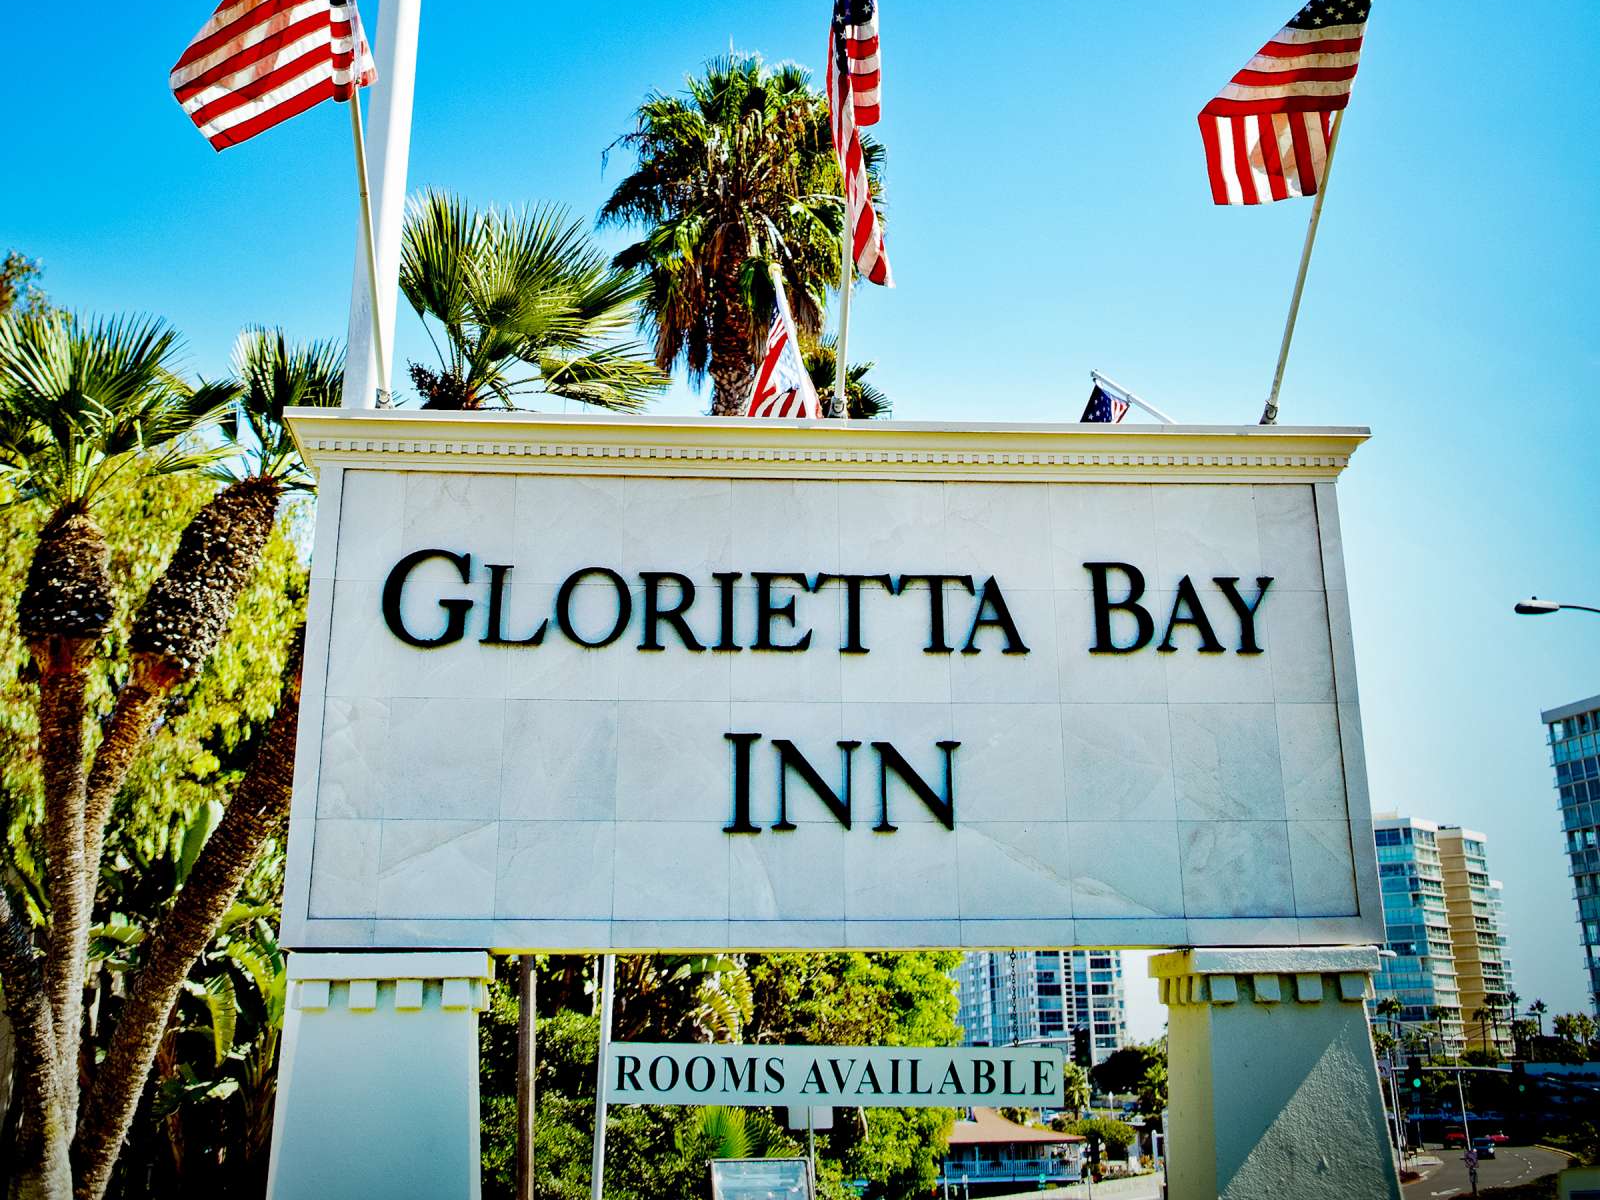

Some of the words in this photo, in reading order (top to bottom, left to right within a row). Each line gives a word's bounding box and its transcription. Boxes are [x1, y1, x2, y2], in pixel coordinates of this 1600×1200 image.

[382, 548, 1031, 655] GLORIETTA
[1084, 562, 1275, 655] BAY
[723, 732, 961, 834] INN
[615, 1055, 786, 1094] ROOMS
[800, 1058, 1057, 1096] AVAILABLE
